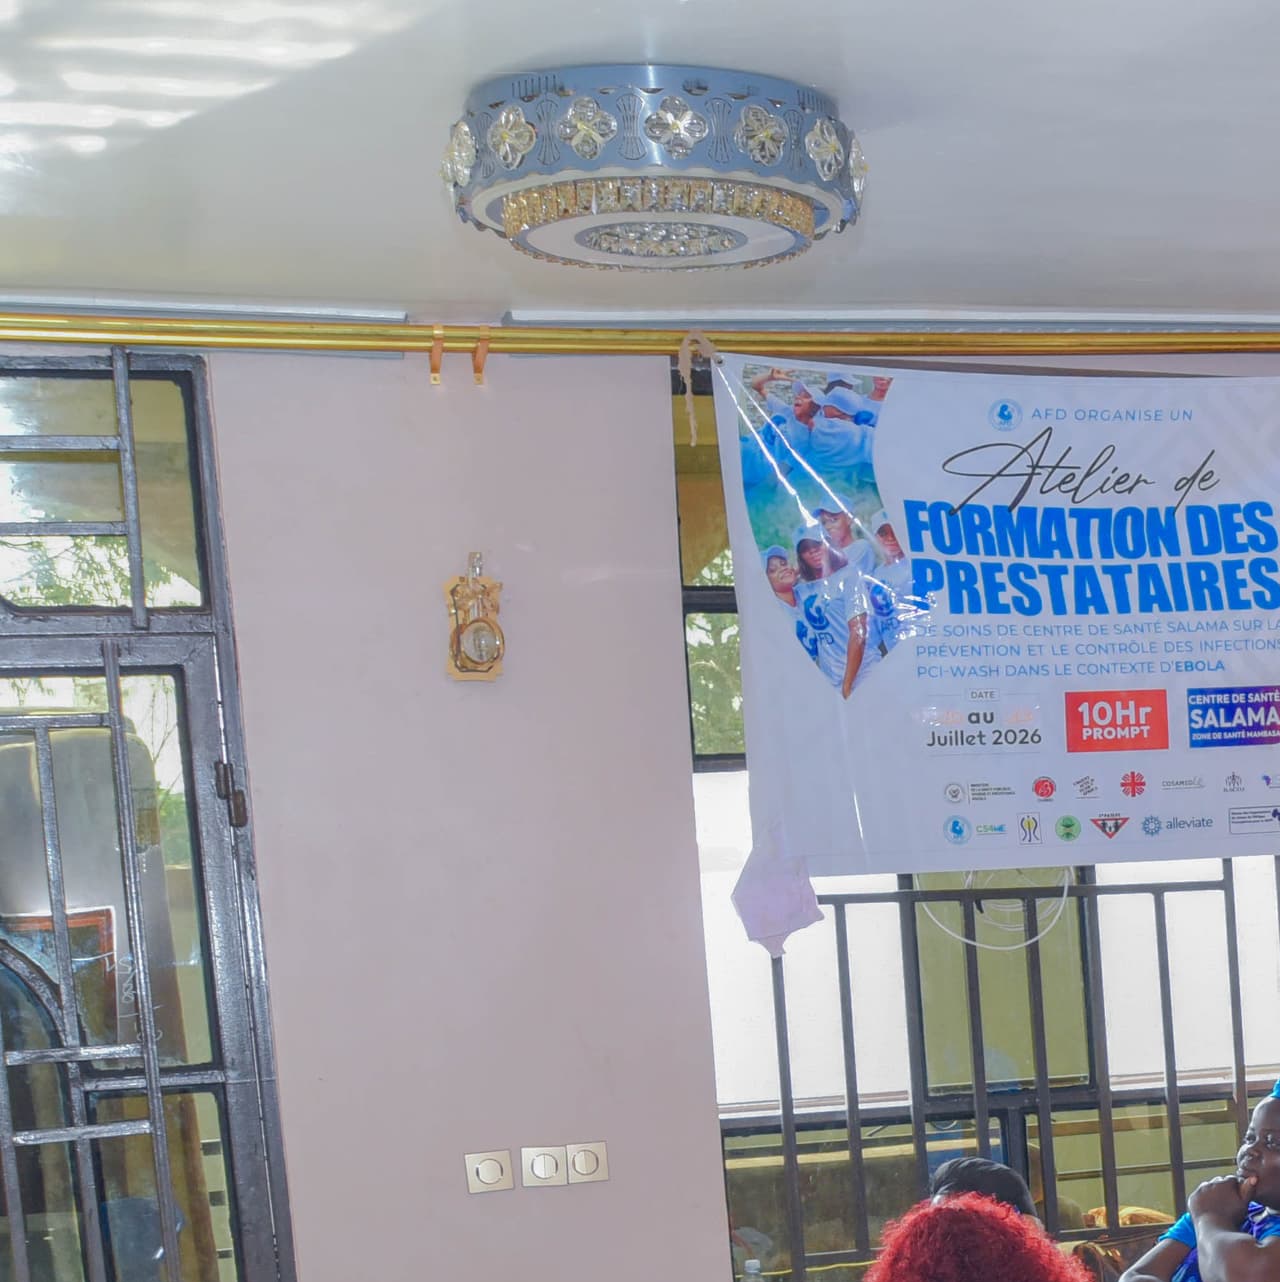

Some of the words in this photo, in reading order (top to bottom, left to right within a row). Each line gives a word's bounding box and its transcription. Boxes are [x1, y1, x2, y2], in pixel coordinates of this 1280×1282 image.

[1031, 408, 1066, 420] AFD
[1074, 409, 1163, 422] ORGANISE
[1169, 409, 1193, 421] UN
[942, 426, 1156, 516] Atelier
[1172, 449, 1220, 517] de
[904, 499, 1179, 560] FORMATION
[1186, 501, 1279, 554] DES
[943, 624, 992, 637] SOINS
[997, 624, 1018, 636] DE
[1023, 624, 1085, 636] CENTRE
[1088, 624, 1108, 635] DE
[1114, 619, 1161, 635] SANTÉ
[1167, 621, 1229, 633] SALAMA
[1234, 620, 1262, 631] SUR
[916, 642, 1021, 657] PRÉVENTION
[1027, 645, 1044, 656] ET
[1051, 644, 1069, 656] LE
[1075, 640, 1157, 656] CONTRÔLE
[1164, 641, 1193, 653] DES
[917, 665, 1000, 678] PCI-WASH
[1005, 664, 1049, 677] DANS
[1054, 664, 1072, 676] LE
[1077, 662, 1157, 675] CONTEXTE
[1160, 660, 1225, 673] D'EBOLA
[971, 691, 995, 699] DATE
[1188, 693, 1230, 705] CENTRE
[1232, 692, 1245, 703] DE
[1248, 689, 1280, 702] SANTÉ
[968, 712, 994, 724] au
[1078, 700, 1152, 726] 10Hr
[927, 730, 987, 747] Juillet
[992, 729, 1042, 746] 2026
[1082, 726, 1150, 740] PROMPT
[1166, 817, 1213, 829] alleviate
